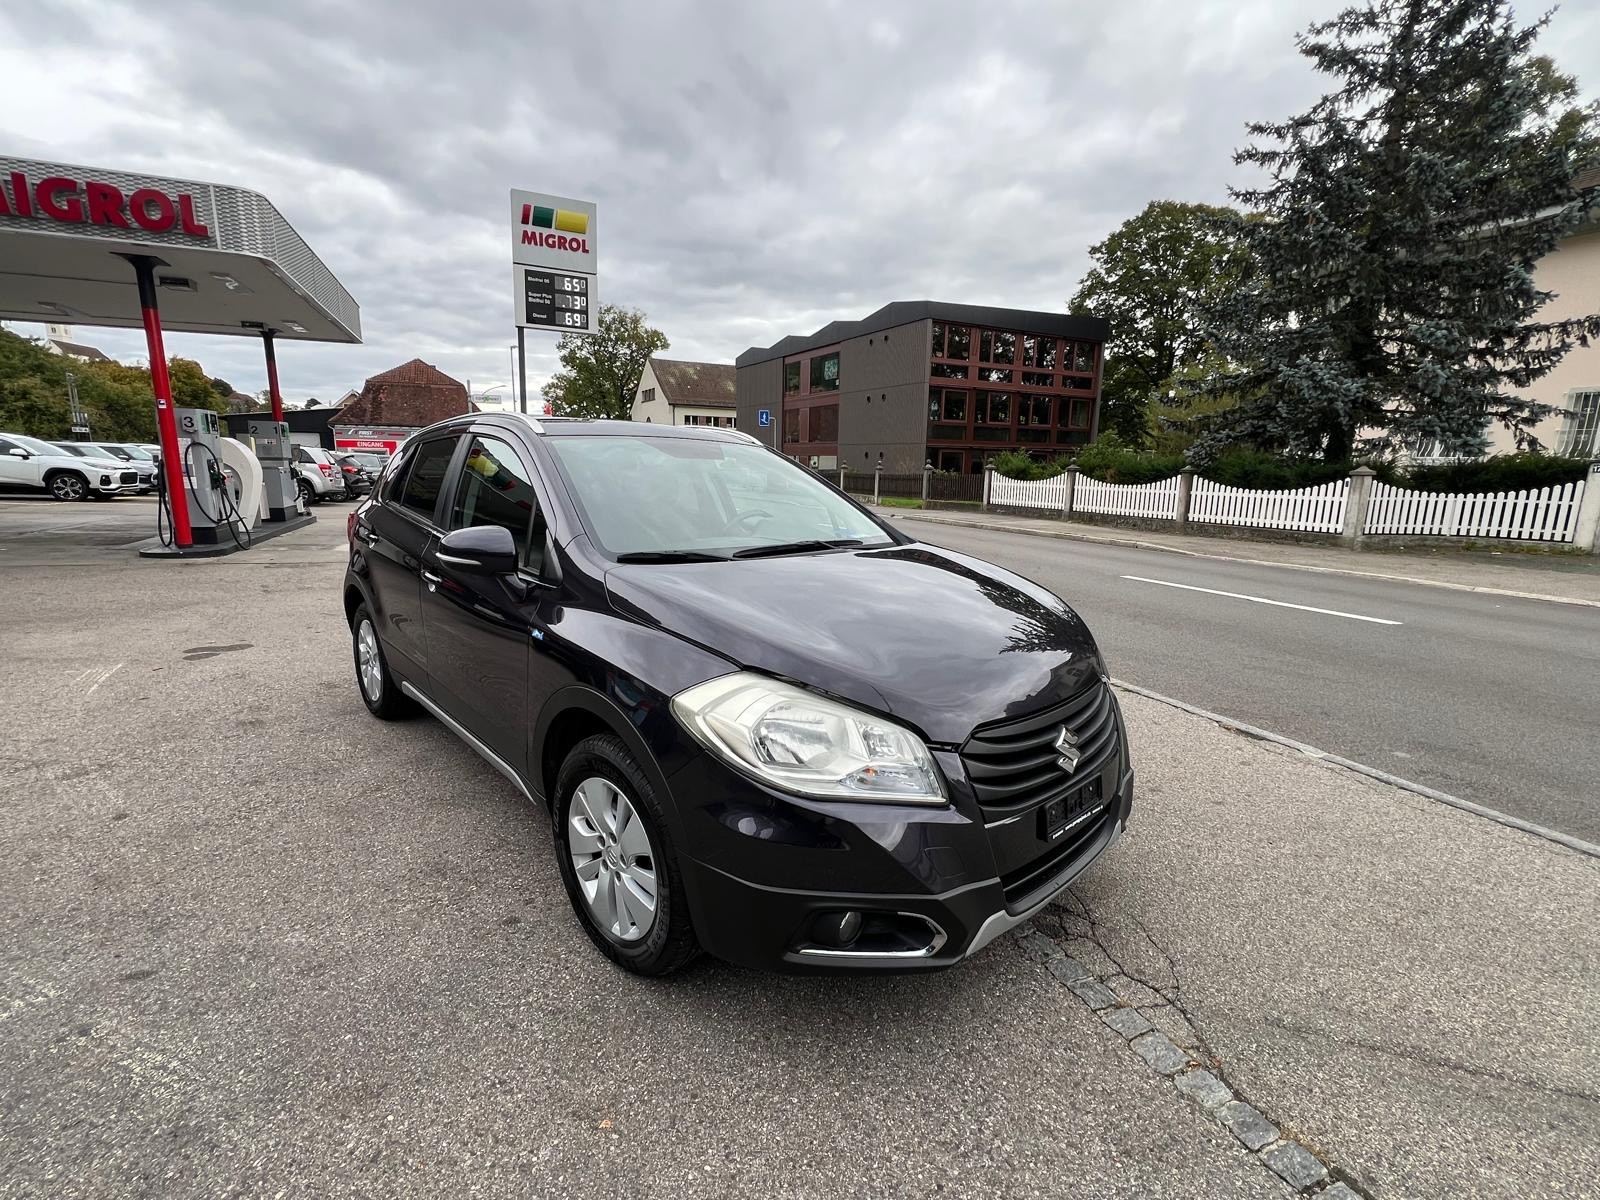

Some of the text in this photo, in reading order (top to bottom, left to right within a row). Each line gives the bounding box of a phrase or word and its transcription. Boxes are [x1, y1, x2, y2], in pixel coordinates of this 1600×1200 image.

[0, 171, 210, 238] IGROL
[521, 229, 590, 254] MIGROL
[183, 416, 195, 428] 3
[250, 425, 258, 434] 2
[273, 426, 278, 434] 1
